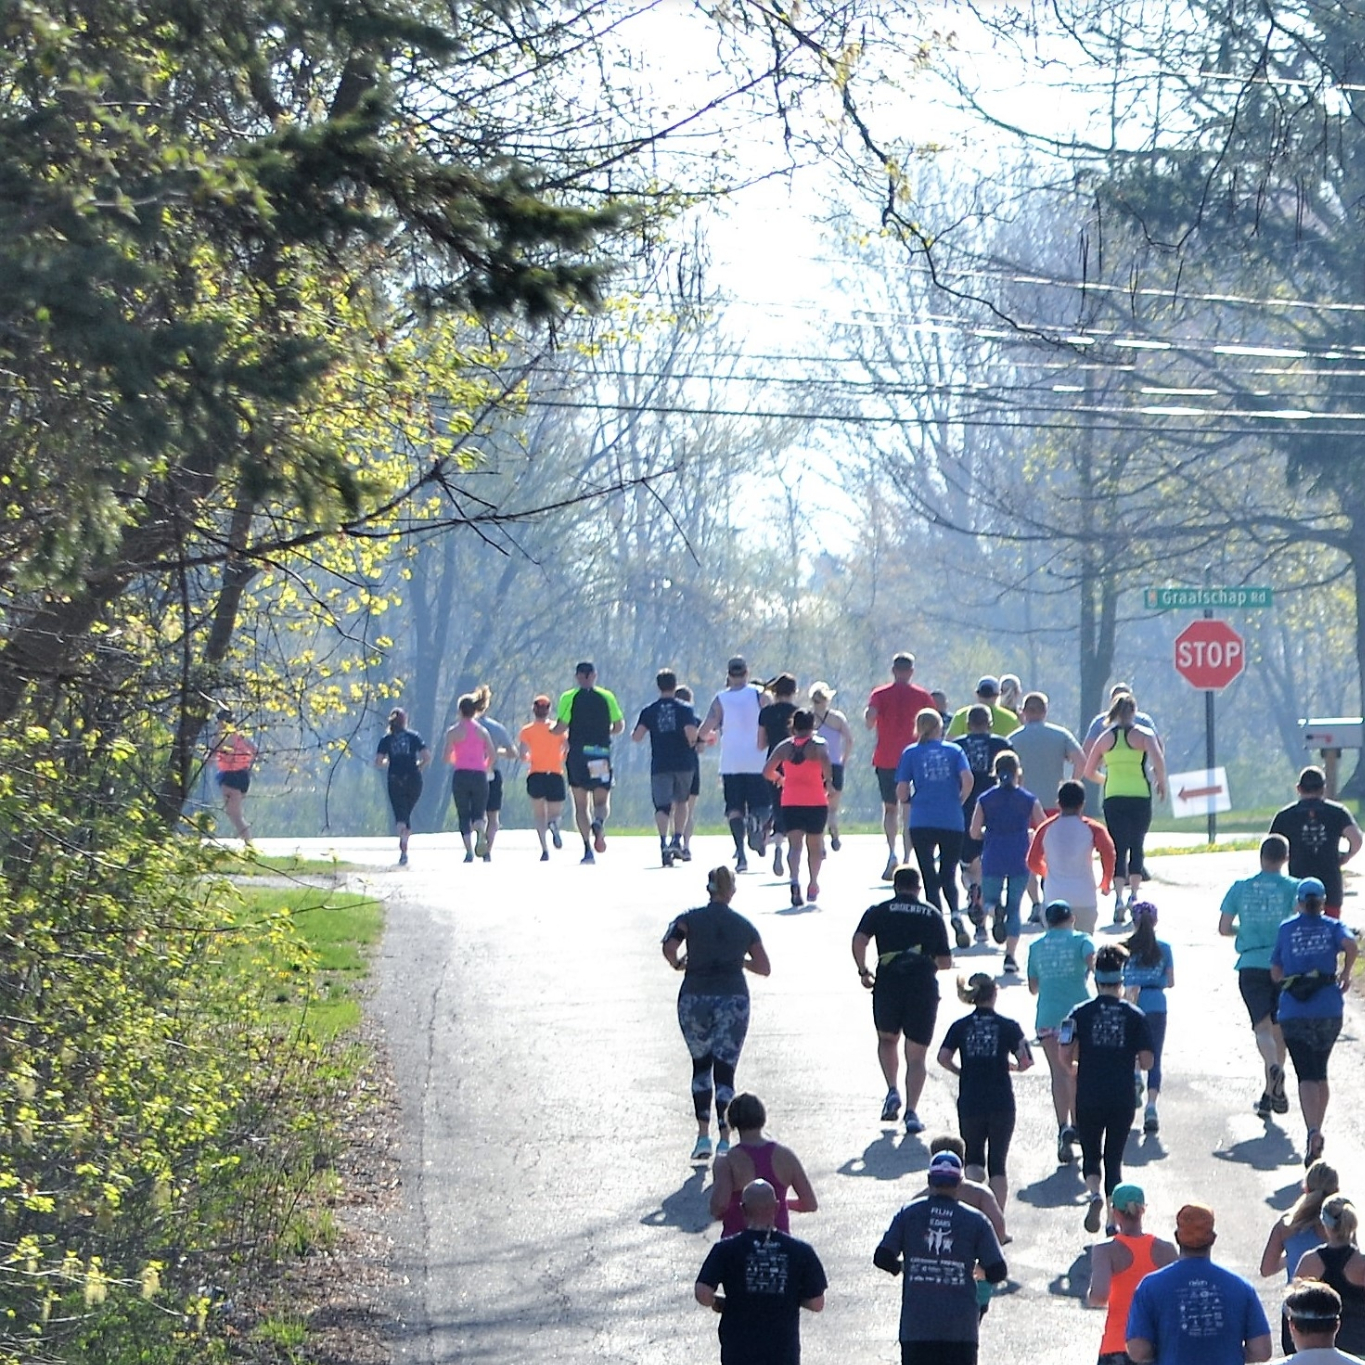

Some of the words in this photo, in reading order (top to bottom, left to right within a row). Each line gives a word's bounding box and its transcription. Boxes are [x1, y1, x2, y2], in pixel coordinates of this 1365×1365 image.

[1162, 589, 1247, 606] Graafschap
[1250, 591, 1266, 603] Rd
[1178, 641, 1241, 668] STOP
[930, 1207, 954, 1217] RUN
